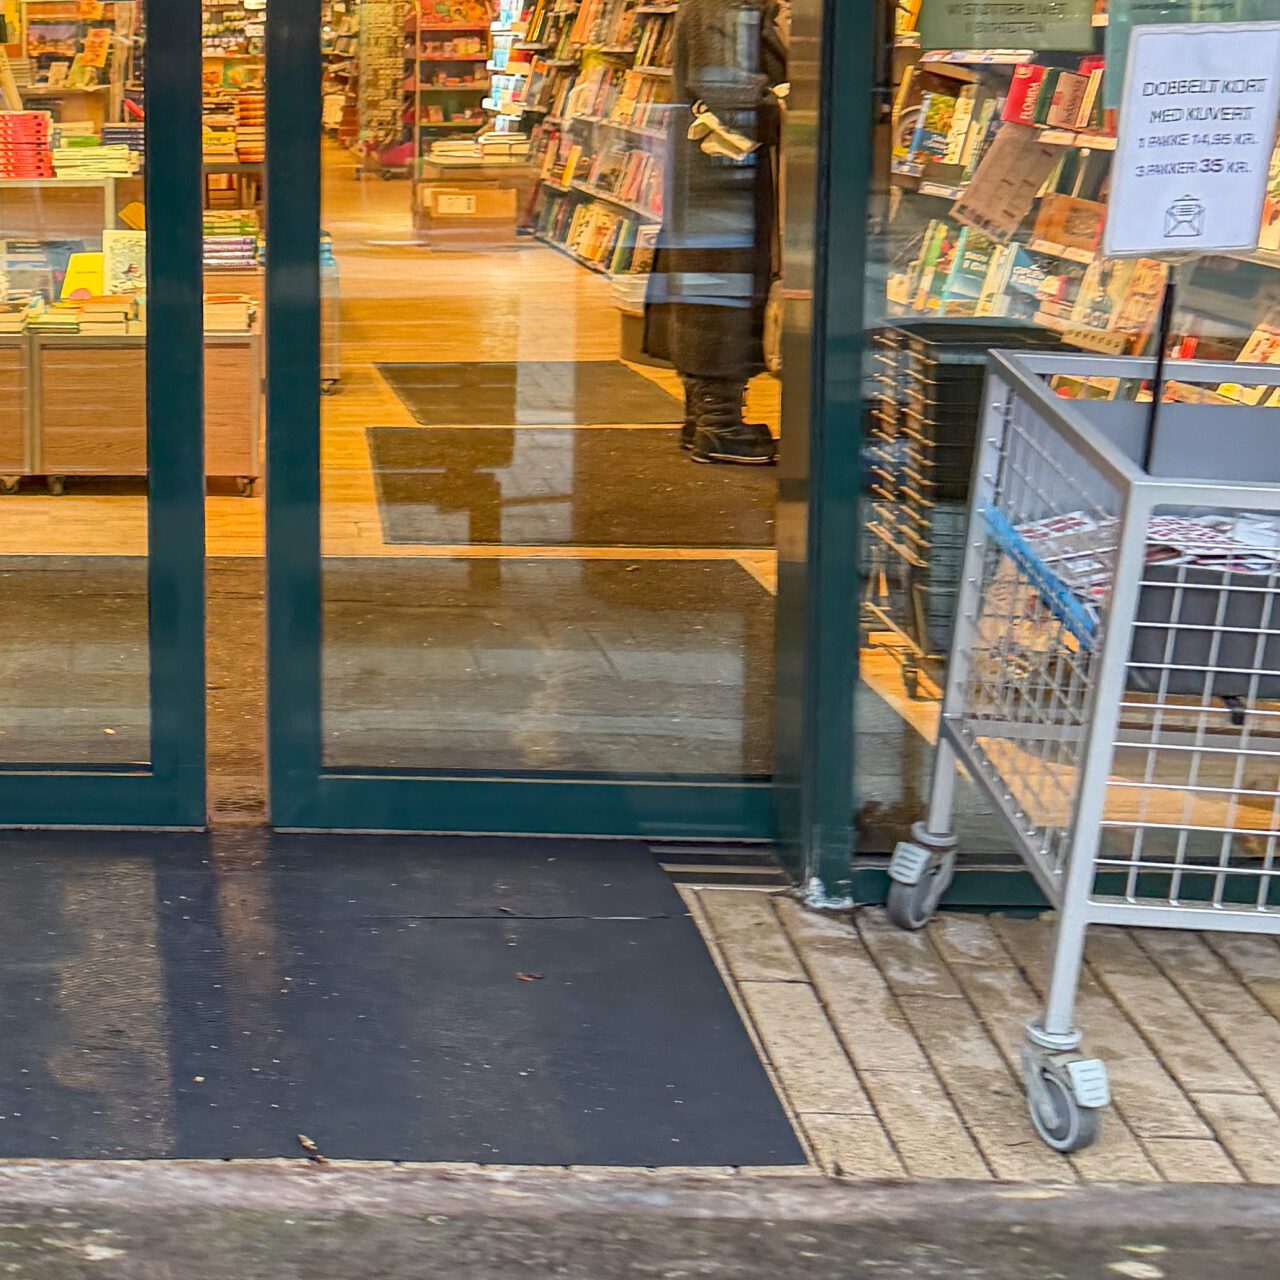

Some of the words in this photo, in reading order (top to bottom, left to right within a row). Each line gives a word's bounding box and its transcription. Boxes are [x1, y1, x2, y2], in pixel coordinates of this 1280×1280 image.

[1143, 79, 1220, 97] DOBBELT
[1222, 78, 1269, 94] KORT
[1149, 108, 1184, 123] MED
[1186, 106, 1257, 122] KUVERT
[1200, 158, 1226, 173] 35
